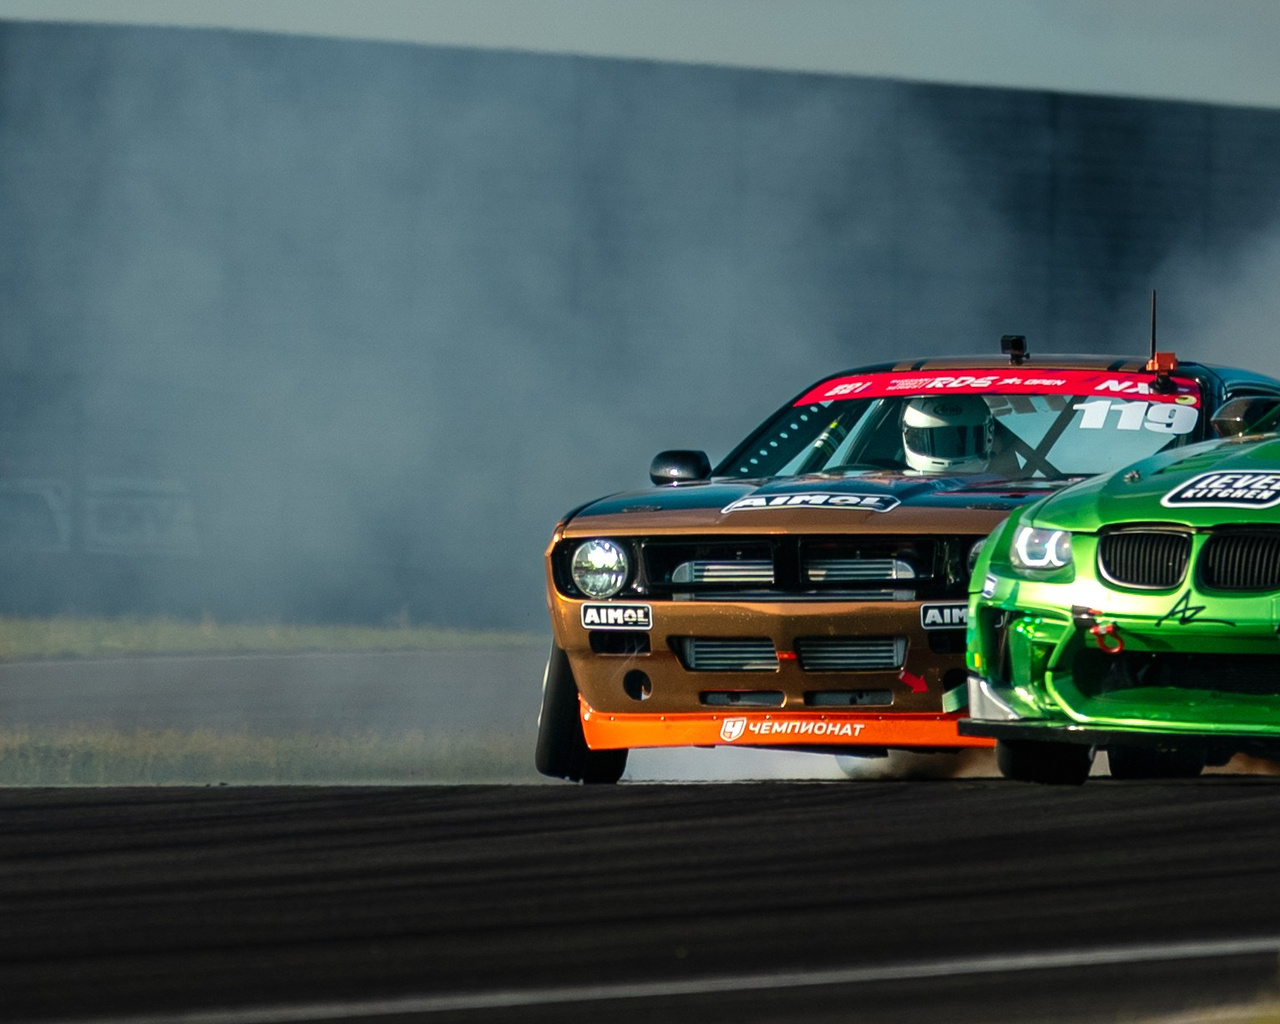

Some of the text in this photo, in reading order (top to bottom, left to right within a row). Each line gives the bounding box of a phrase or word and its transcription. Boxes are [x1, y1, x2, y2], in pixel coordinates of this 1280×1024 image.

[925, 376, 999, 388] RDS
[1024, 378, 1066, 386] OPEN
[1094, 379, 1190, 395] NX
[1073, 400, 1199, 434] 119
[733, 495, 884, 506] AIMOL
[1180, 489, 1276, 499] KITCHEN
[584, 607, 649, 625] AIMOL
[749, 721, 864, 736] ЧЕМПИОНАТ
